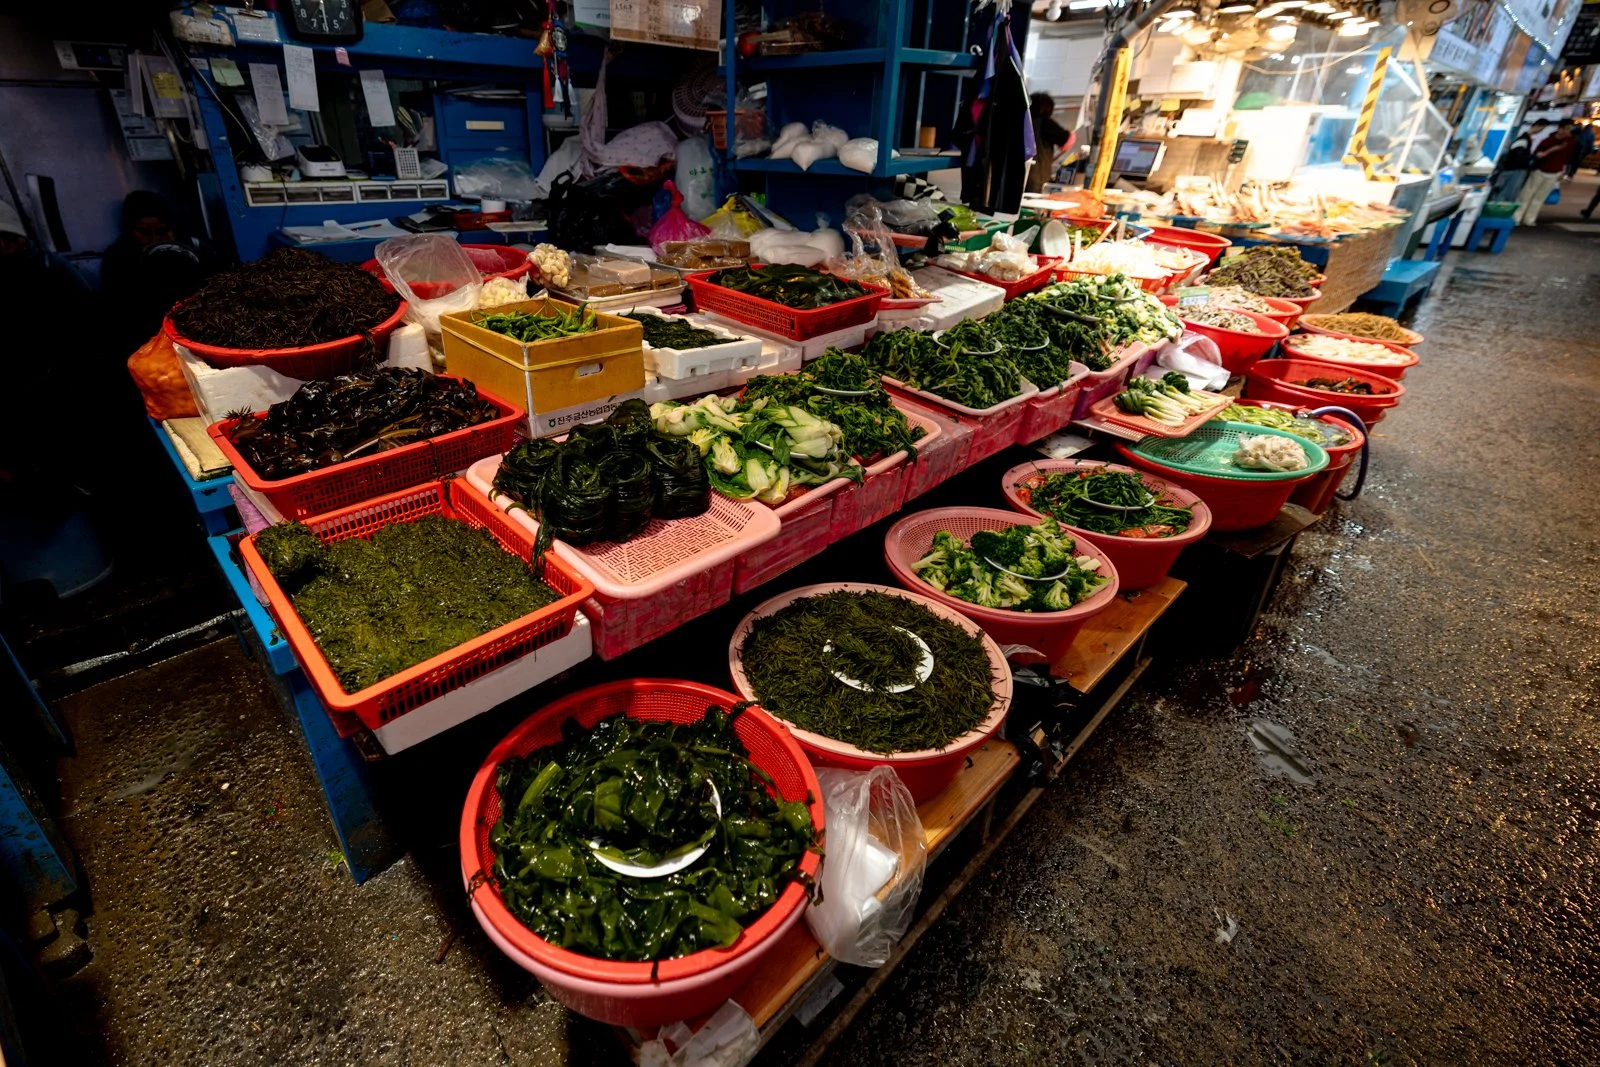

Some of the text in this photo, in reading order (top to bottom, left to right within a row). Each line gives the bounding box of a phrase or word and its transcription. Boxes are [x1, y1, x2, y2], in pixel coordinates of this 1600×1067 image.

[300, 8, 307, 18] 8
[339, 10, 345, 20] 4
[311, 18, 317, 28] 7
[333, 19, 340, 29] 5
